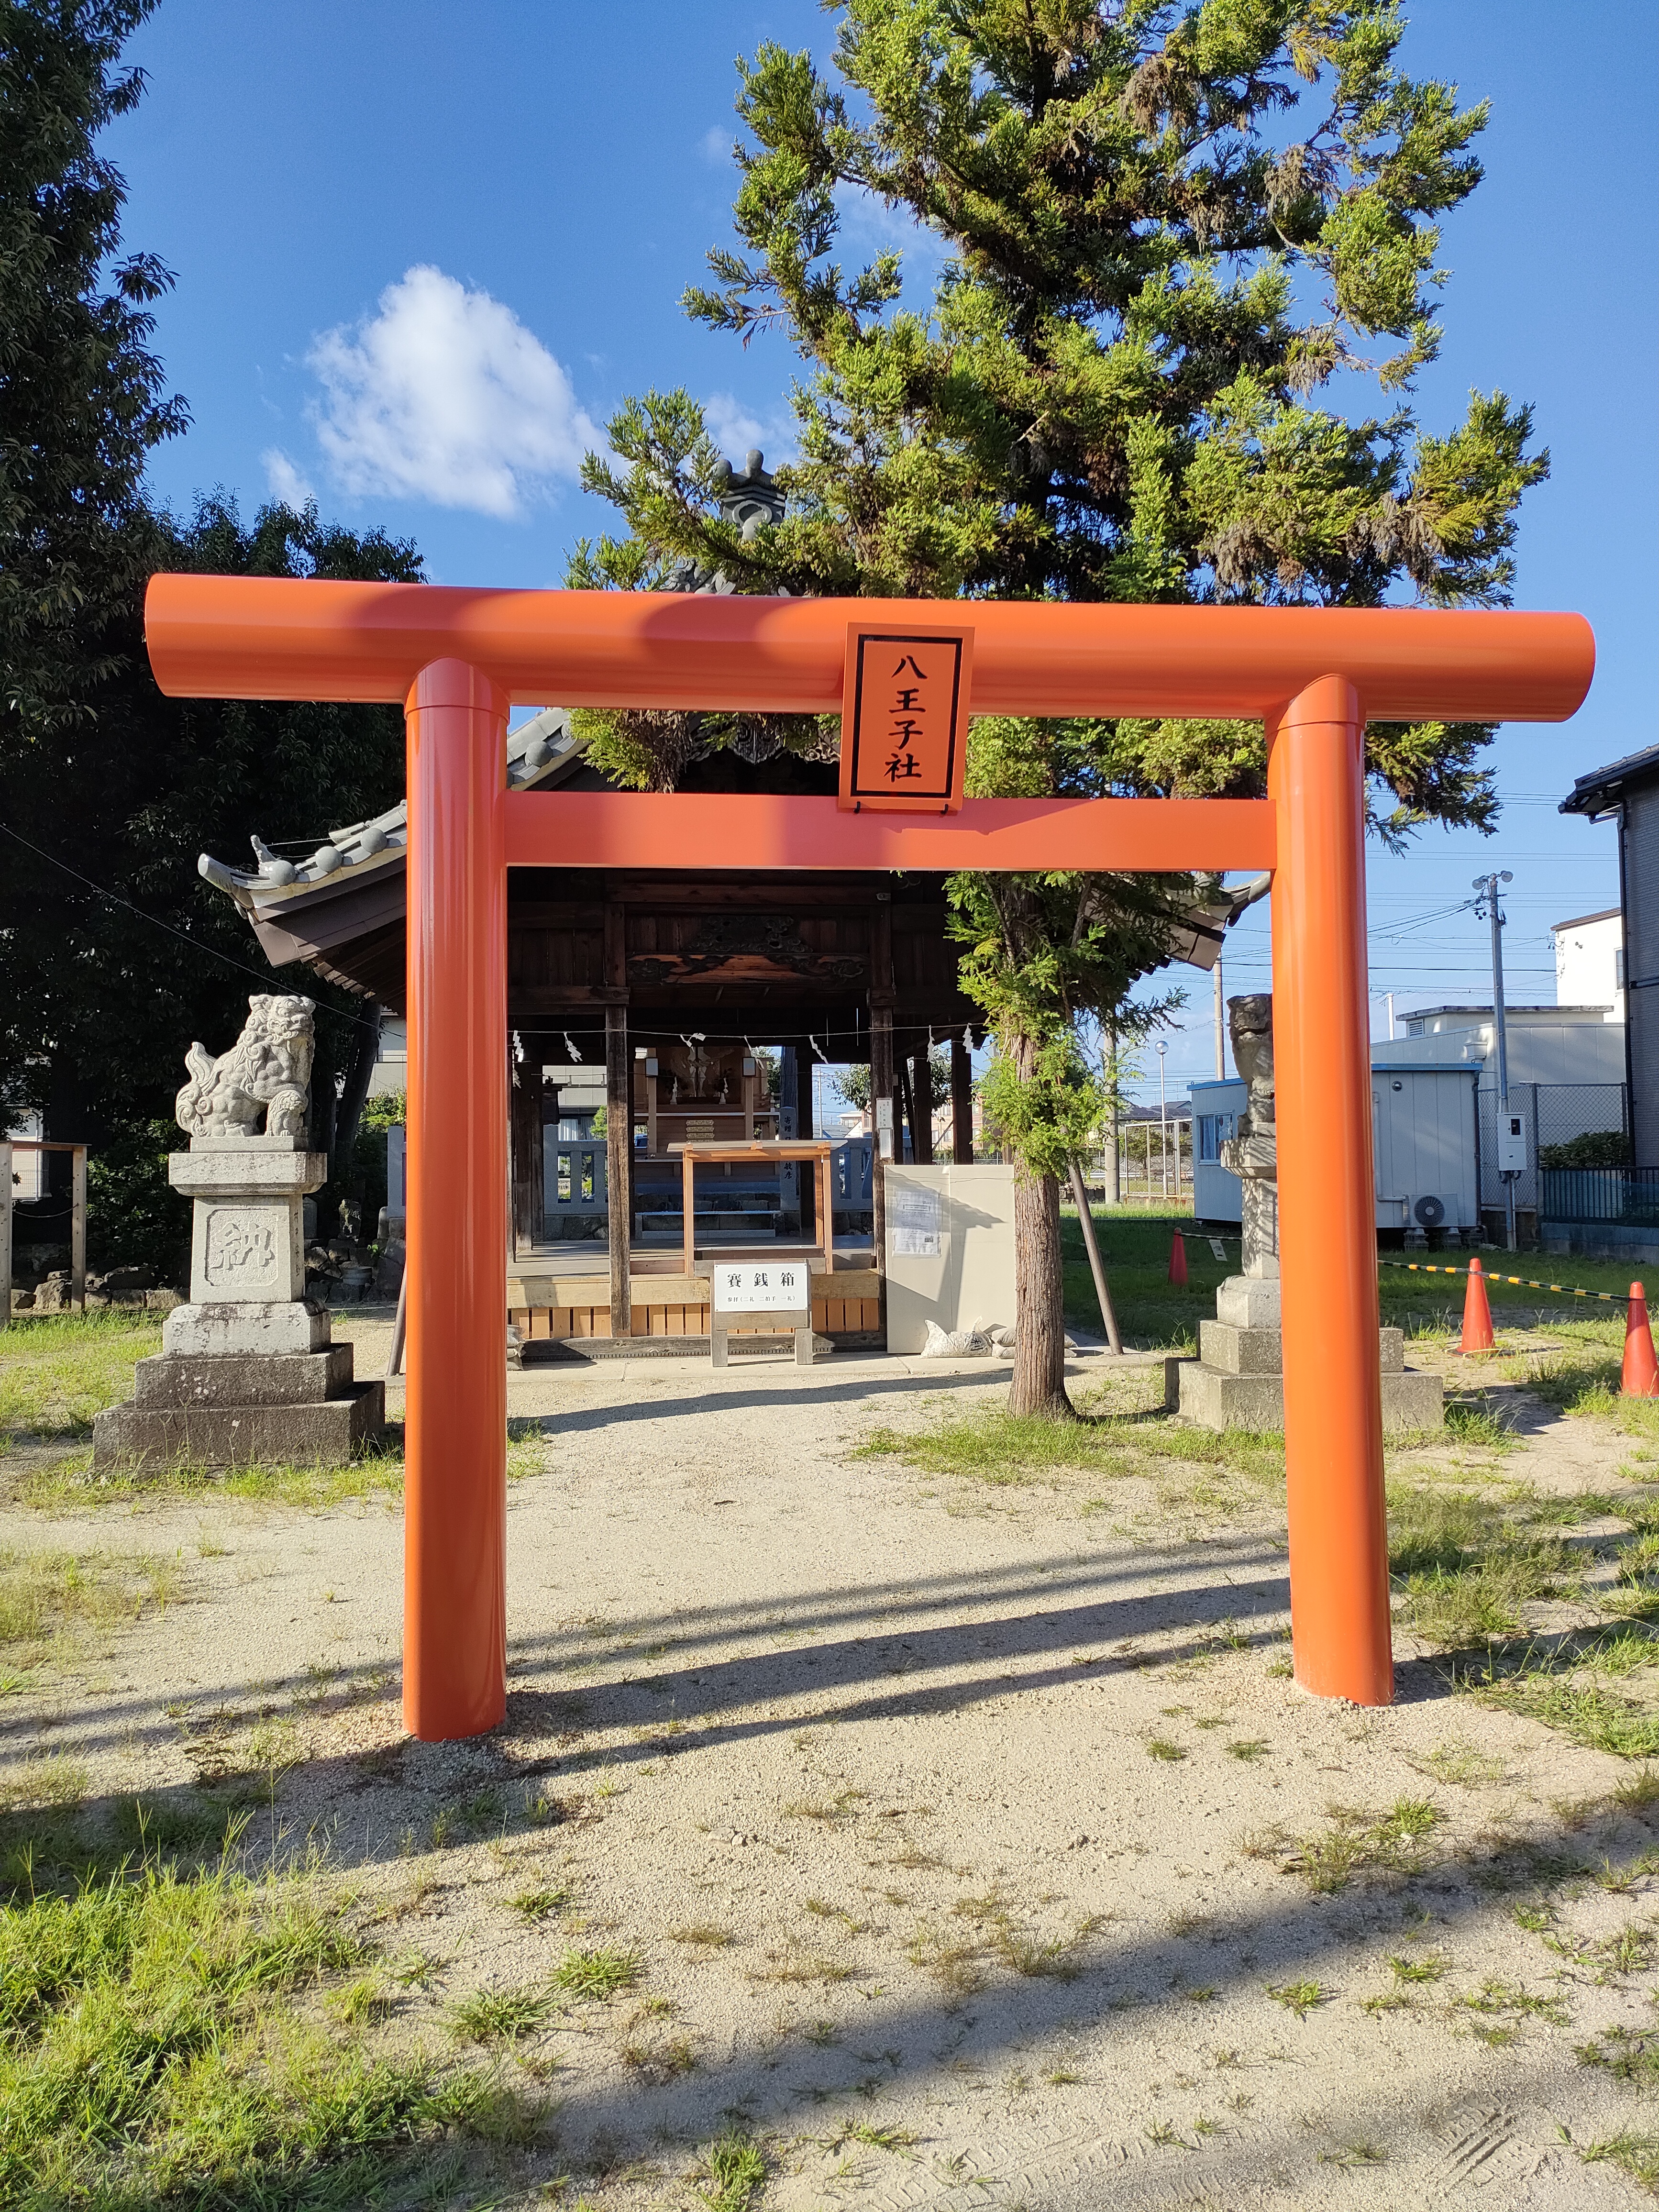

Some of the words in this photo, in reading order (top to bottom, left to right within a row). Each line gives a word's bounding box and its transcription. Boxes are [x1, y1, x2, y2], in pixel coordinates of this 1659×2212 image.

[884, 655, 928, 783] 八王子社
[210, 1222, 276, 1271] 納
[727, 1272, 795, 1288] 賽銭箱
